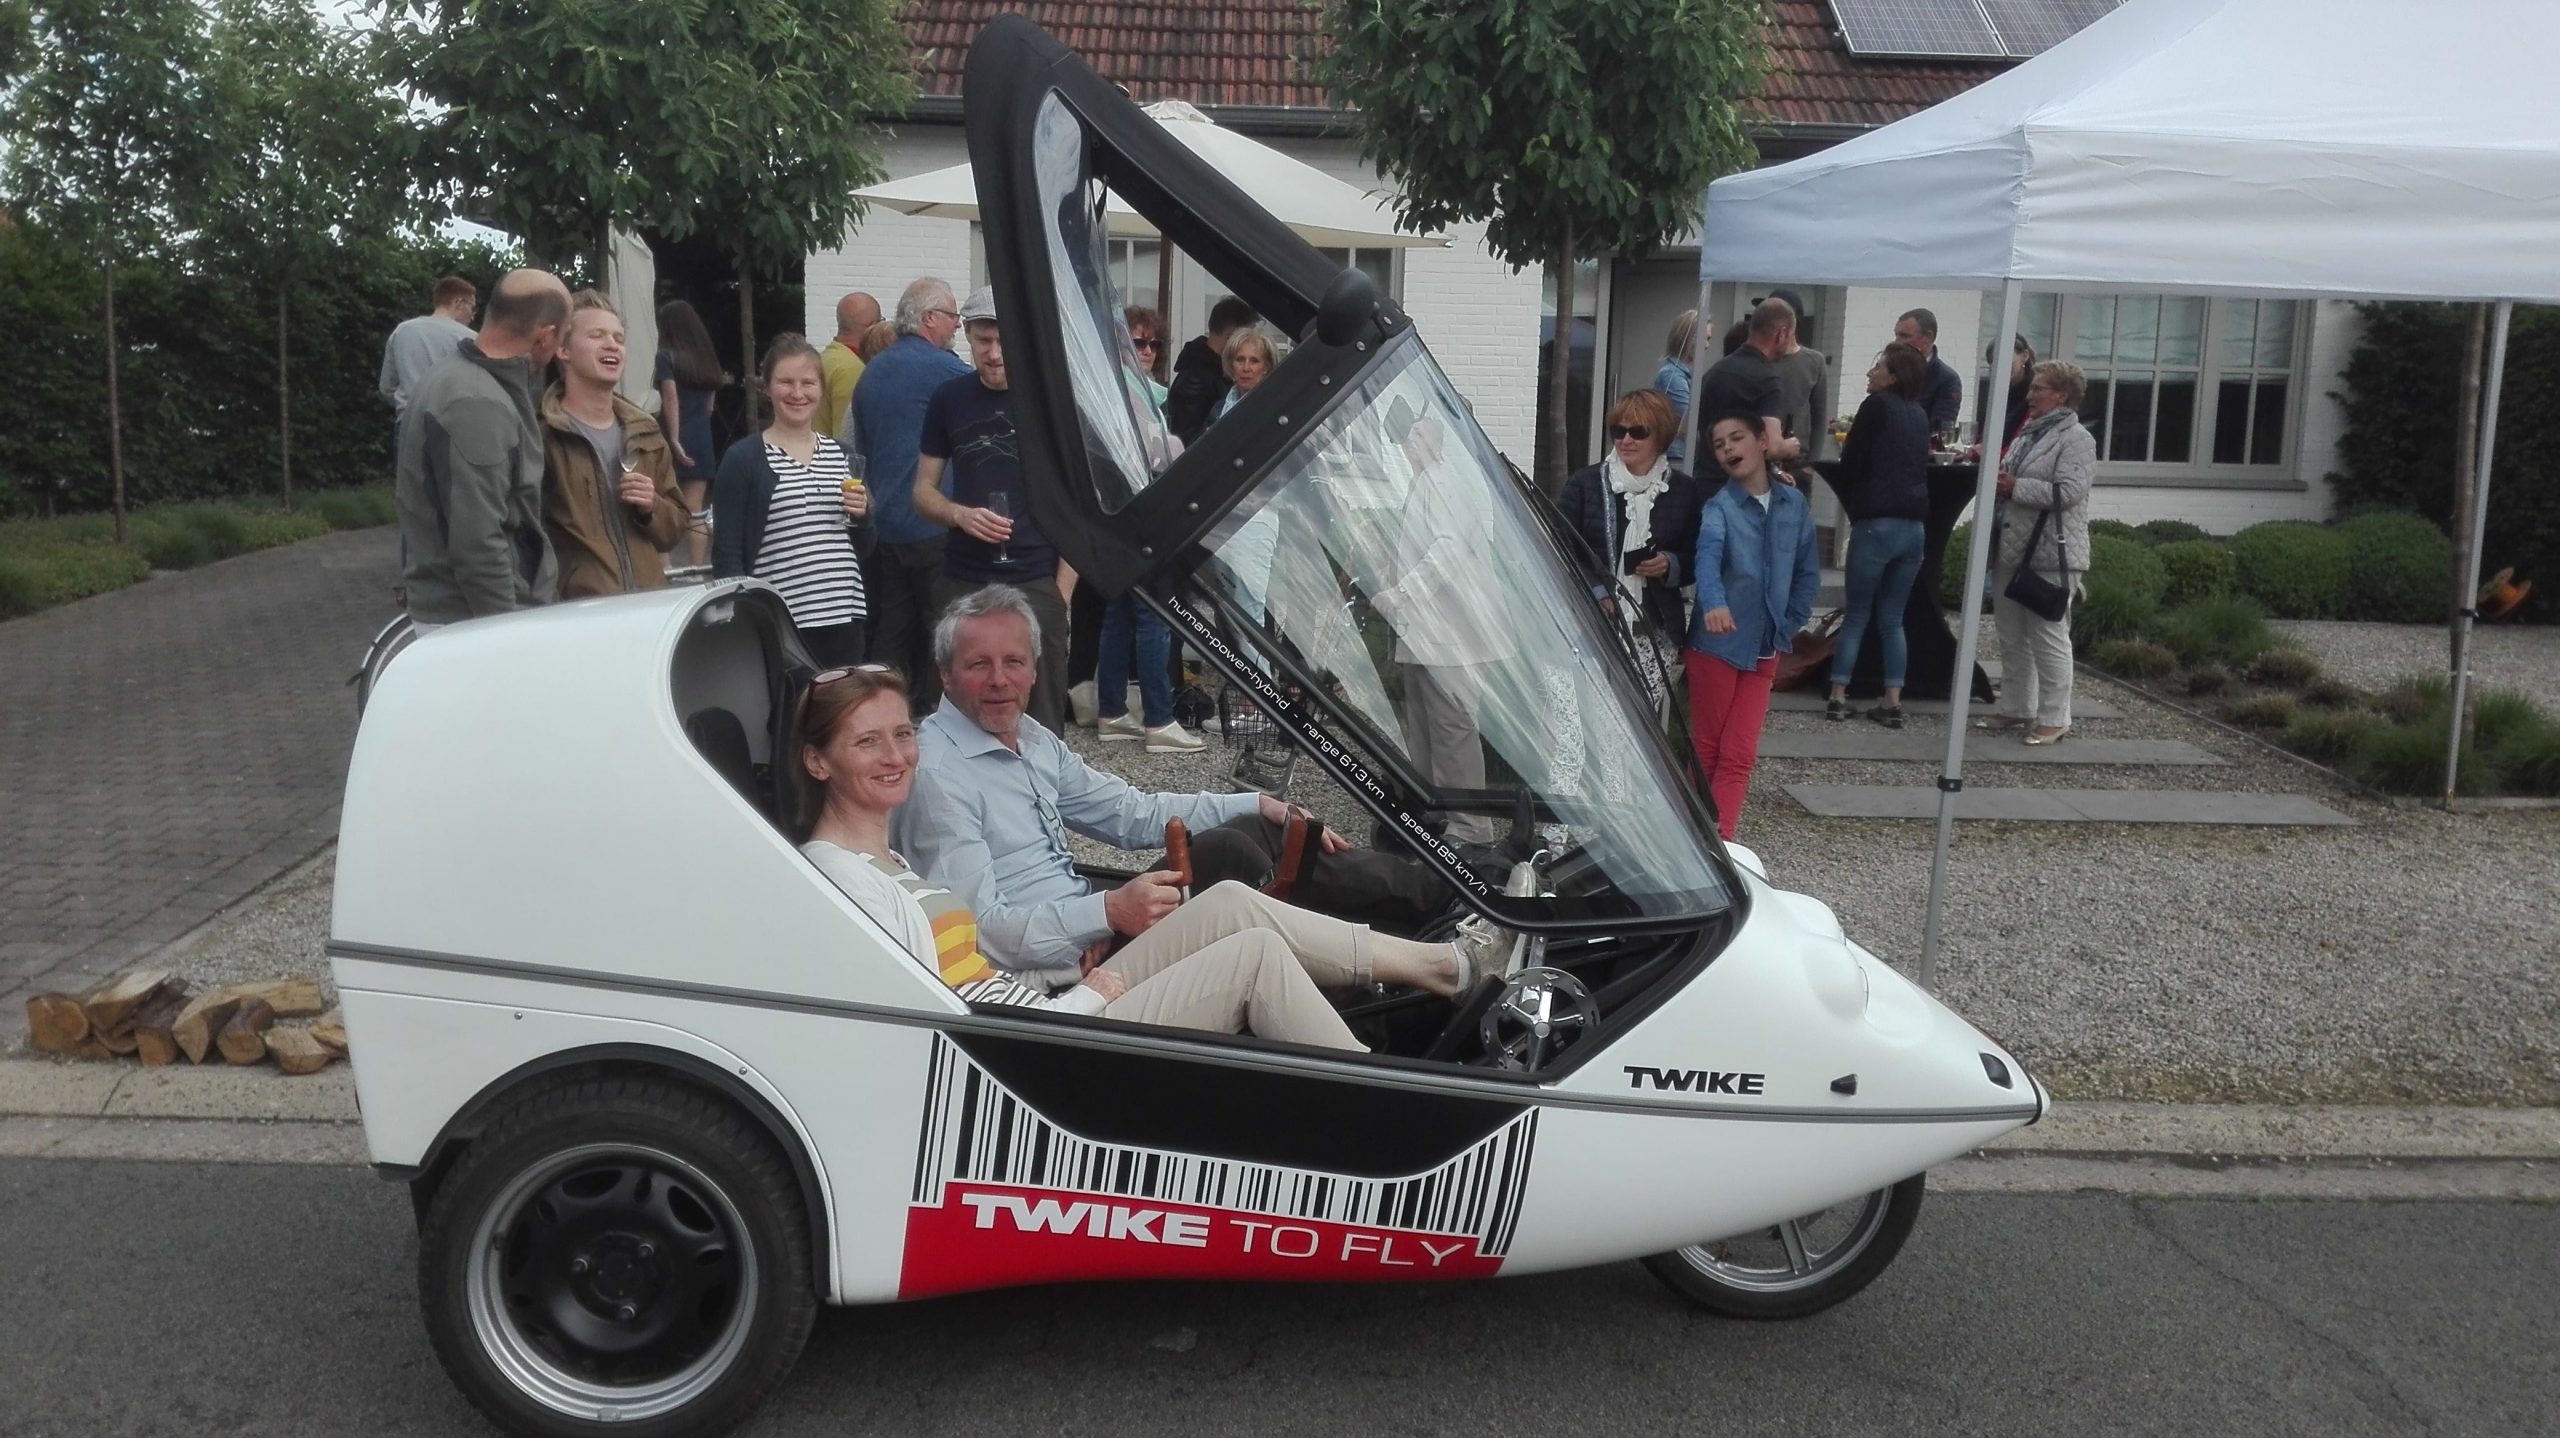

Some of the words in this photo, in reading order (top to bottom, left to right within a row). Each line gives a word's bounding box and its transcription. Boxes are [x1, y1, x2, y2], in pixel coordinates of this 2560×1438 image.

[1168, 595, 1291, 711] human-power-hybrid
[1302, 722, 1340, 758] range
[1339, 754, 1368, 782] 613
[1365, 778, 1385, 800] km
[1400, 812, 1440, 848] speed
[1436, 845, 1458, 865] 85
[1454, 861, 1488, 896] km/h
[1623, 1065, 1766, 1095] TWIKE
[961, 1192, 1211, 1248] TWIKE
[1229, 1219, 1319, 1258] TO
[1340, 1233, 1465, 1267] FLY
